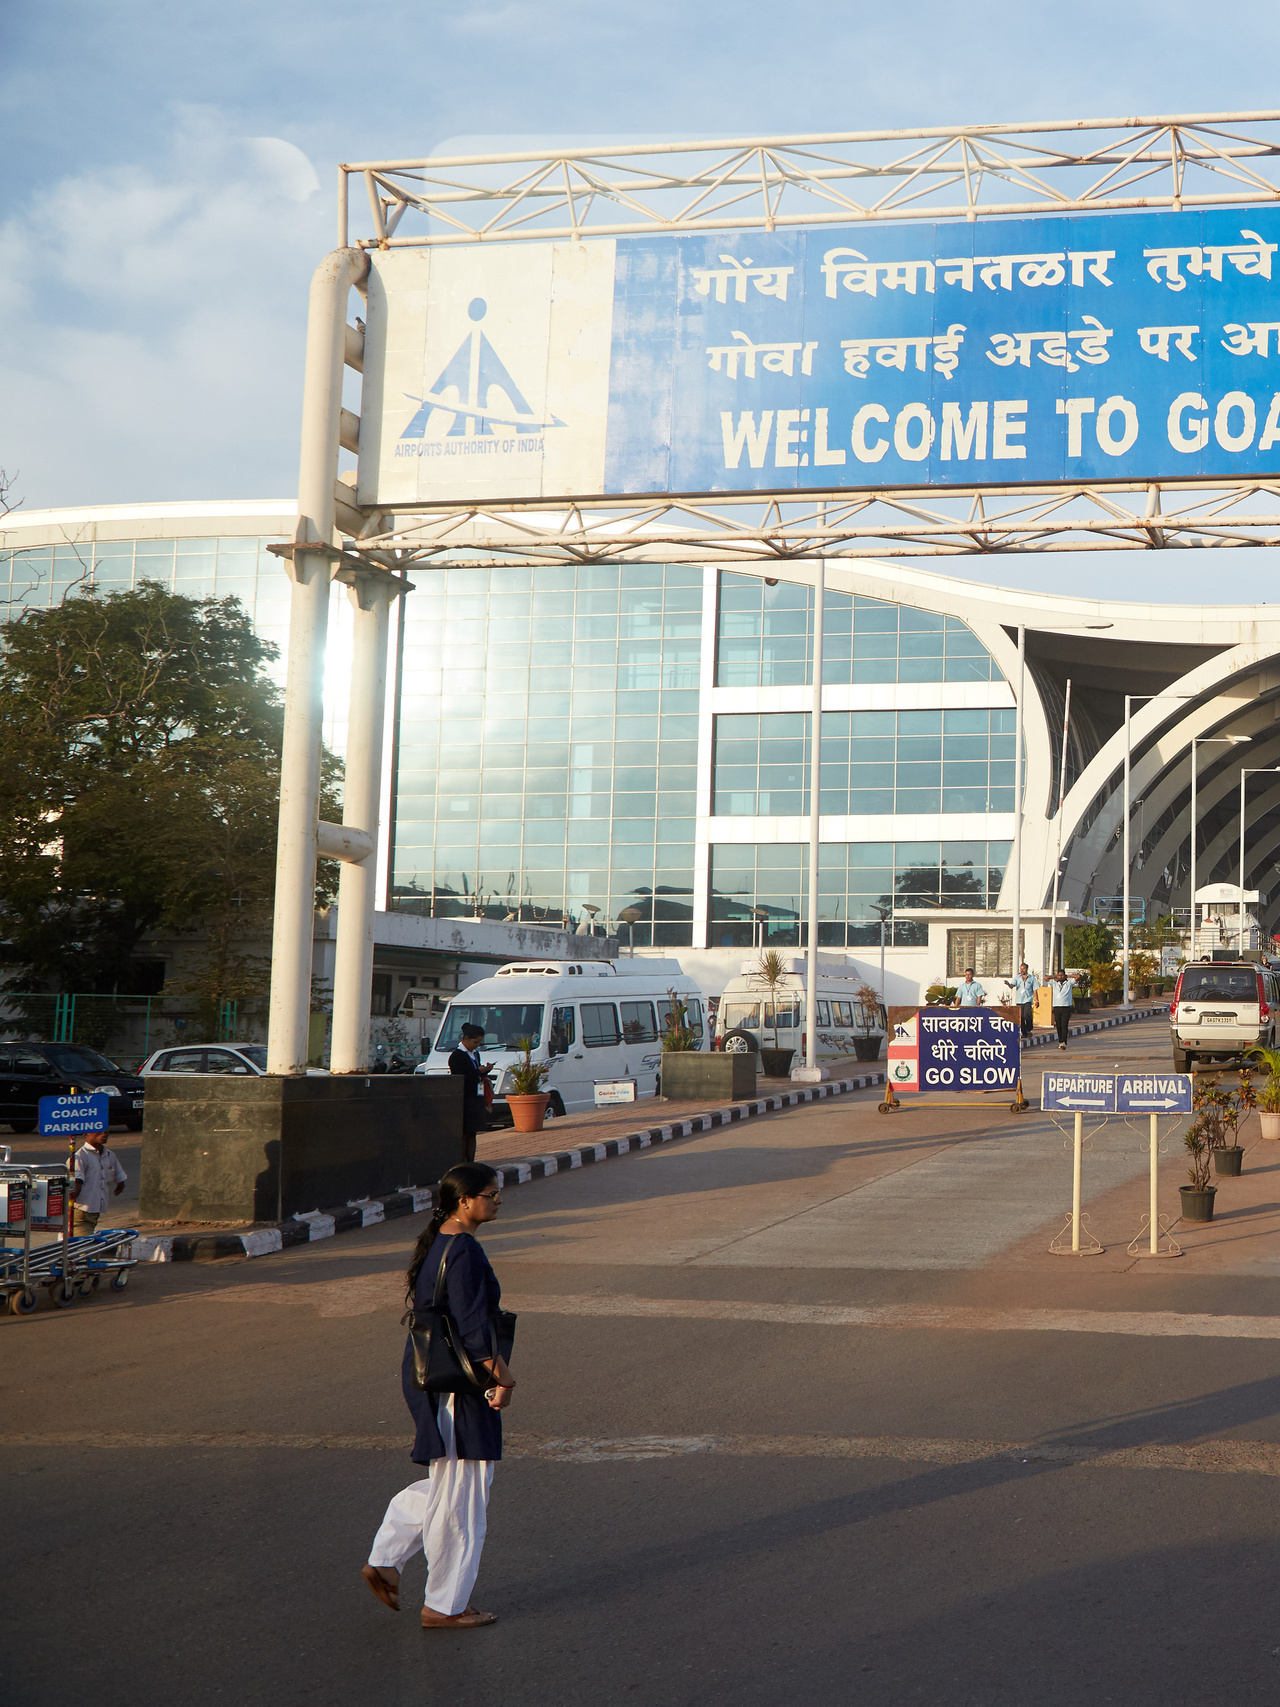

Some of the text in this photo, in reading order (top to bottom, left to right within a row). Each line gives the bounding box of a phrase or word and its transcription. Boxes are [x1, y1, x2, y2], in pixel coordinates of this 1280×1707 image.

[694, 255, 794, 304] गोंय
[821, 247, 1115, 299] विमानतळार
[1143, 229, 1278, 291] तुमचे
[706, 331, 818, 380] गोवा
[840, 324, 967, 380] हवाई
[1138, 325, 1199, 362] पर
[720, 399, 1028, 470] WELCOME
[1055, 395, 1139, 458] TO
[394, 438, 545, 458] AIRPORTS AUTHORITY OF INDIA
[921, 1016, 984, 1033] सावकाश
[931, 1039, 958, 1061] धीरे
[925, 1067, 955, 1085] GO
[960, 1067, 1016, 1085] SLOW
[1048, 1077, 1113, 1094] DEPARTURE
[1122, 1079, 1187, 1094] ARRIVAL
[57, 1095, 93, 1105] ONLY
[51, 1107, 98, 1119] COACH
[44, 1121, 104, 1133] PARKING
